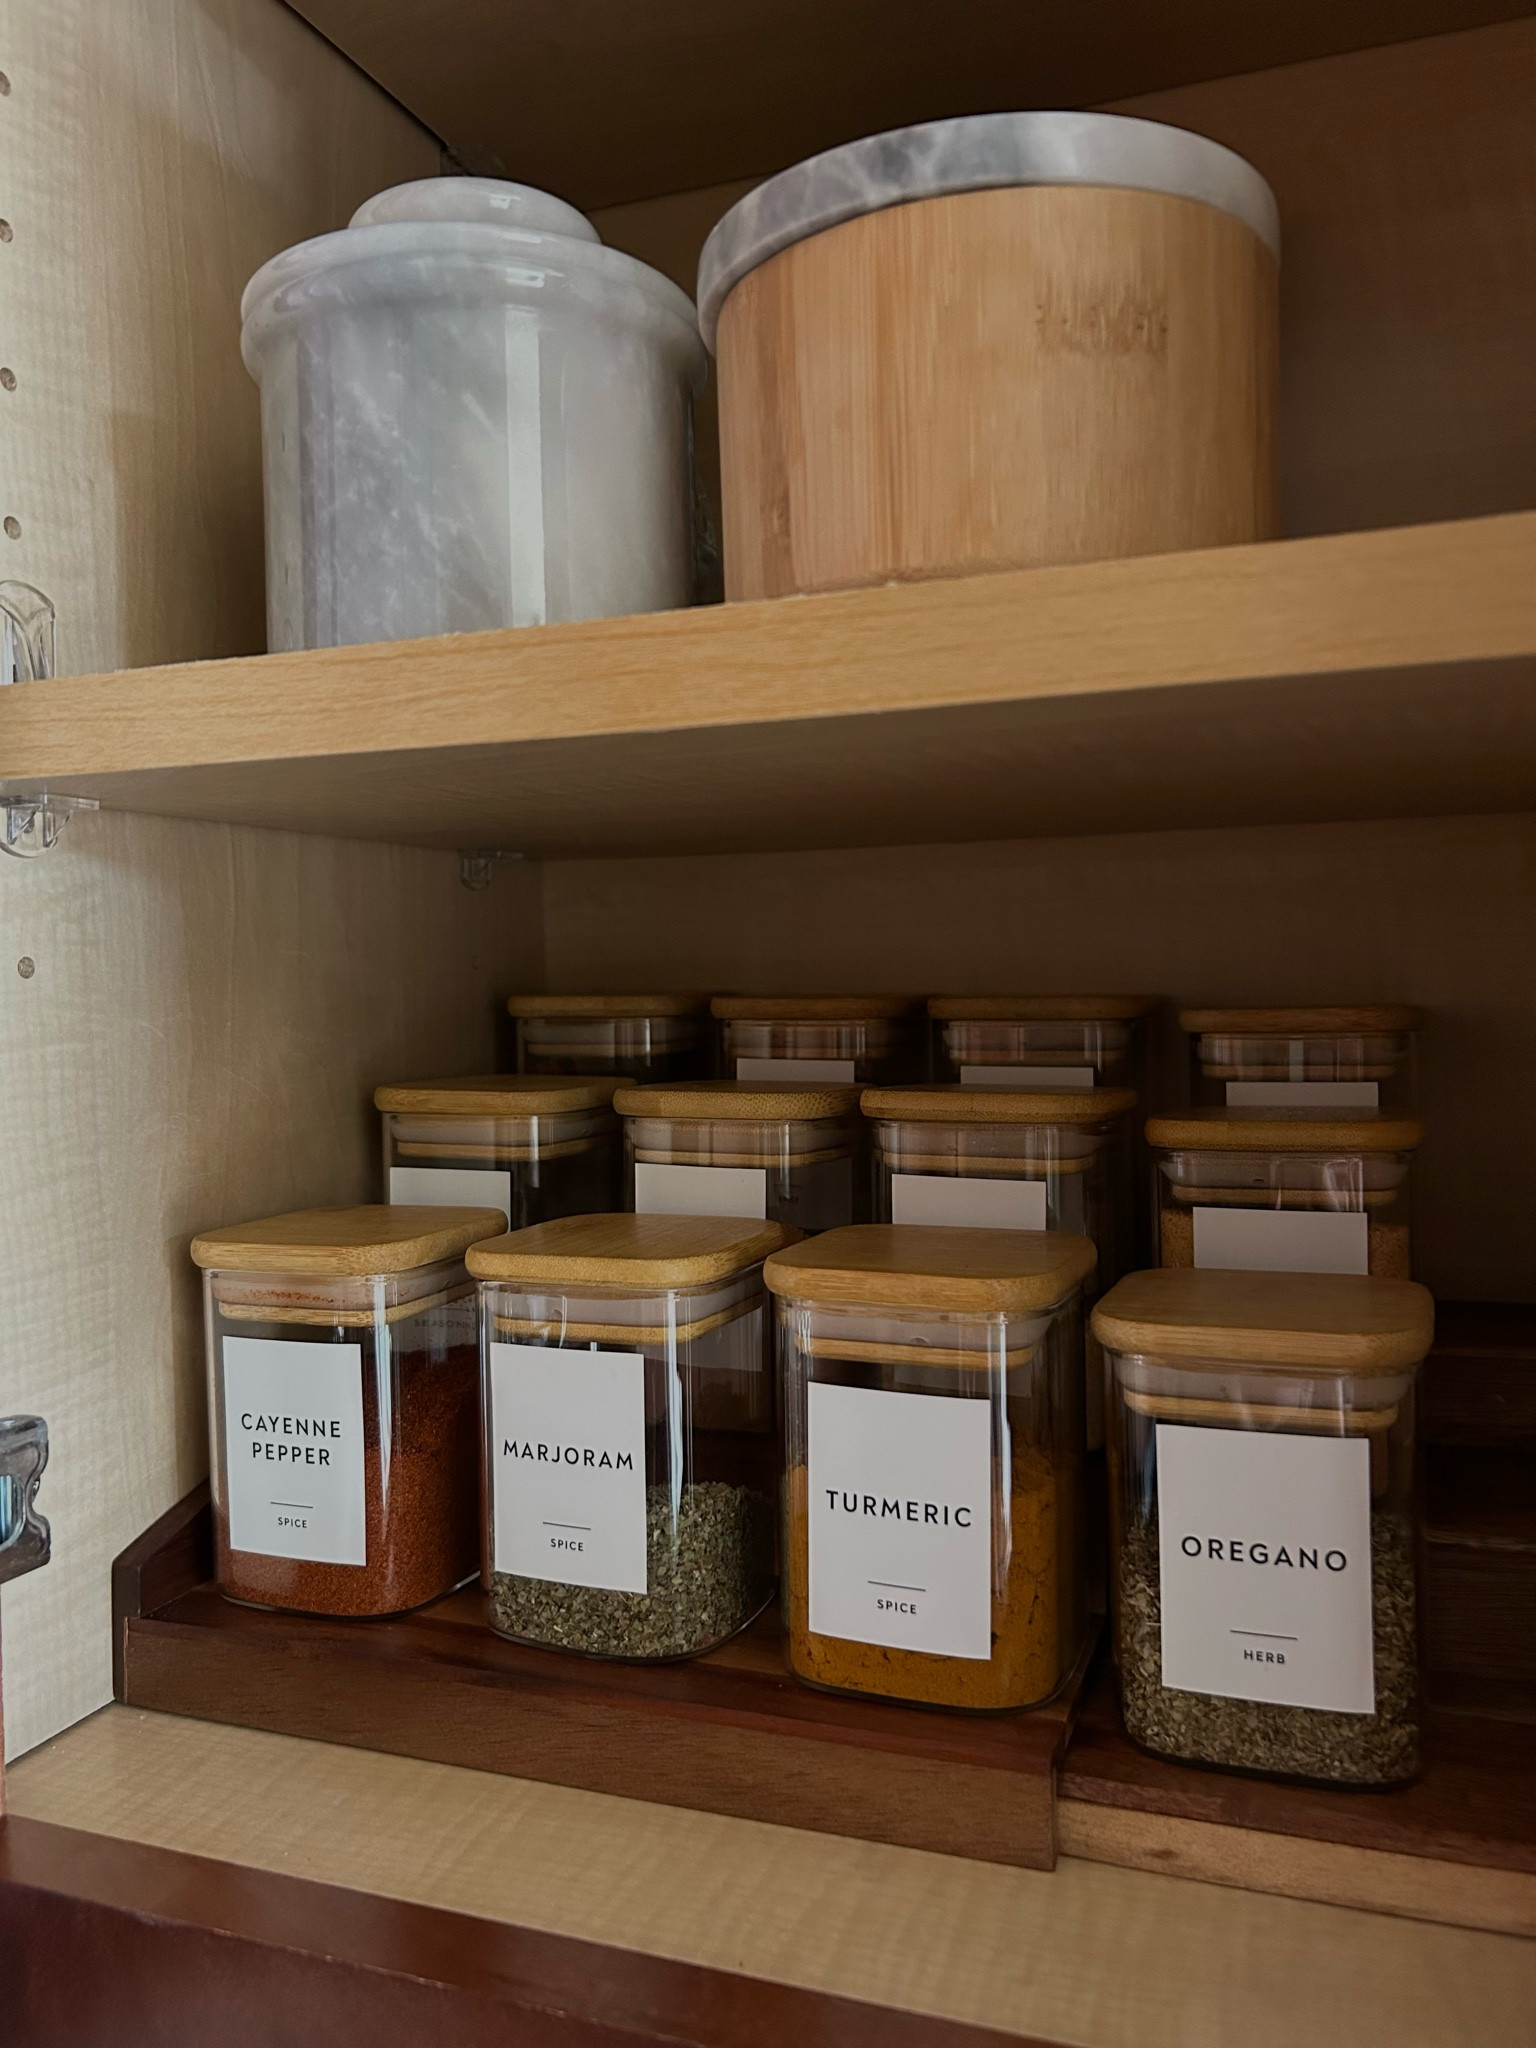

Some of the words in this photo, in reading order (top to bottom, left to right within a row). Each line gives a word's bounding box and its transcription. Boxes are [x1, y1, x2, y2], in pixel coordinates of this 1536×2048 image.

[241, 1412, 341, 1438] CAYENNE
[252, 1441, 332, 1466] PEPPER
[503, 1439, 633, 1471] MARJORAM
[825, 1489, 972, 1528] TURMERIC
[277, 1516, 308, 1529] SPICE
[550, 1538, 584, 1552] SPICE
[1181, 1535, 1348, 1572] OREGANO
[877, 1598, 917, 1615] SPICE
[1243, 1649, 1286, 1665] HERB
